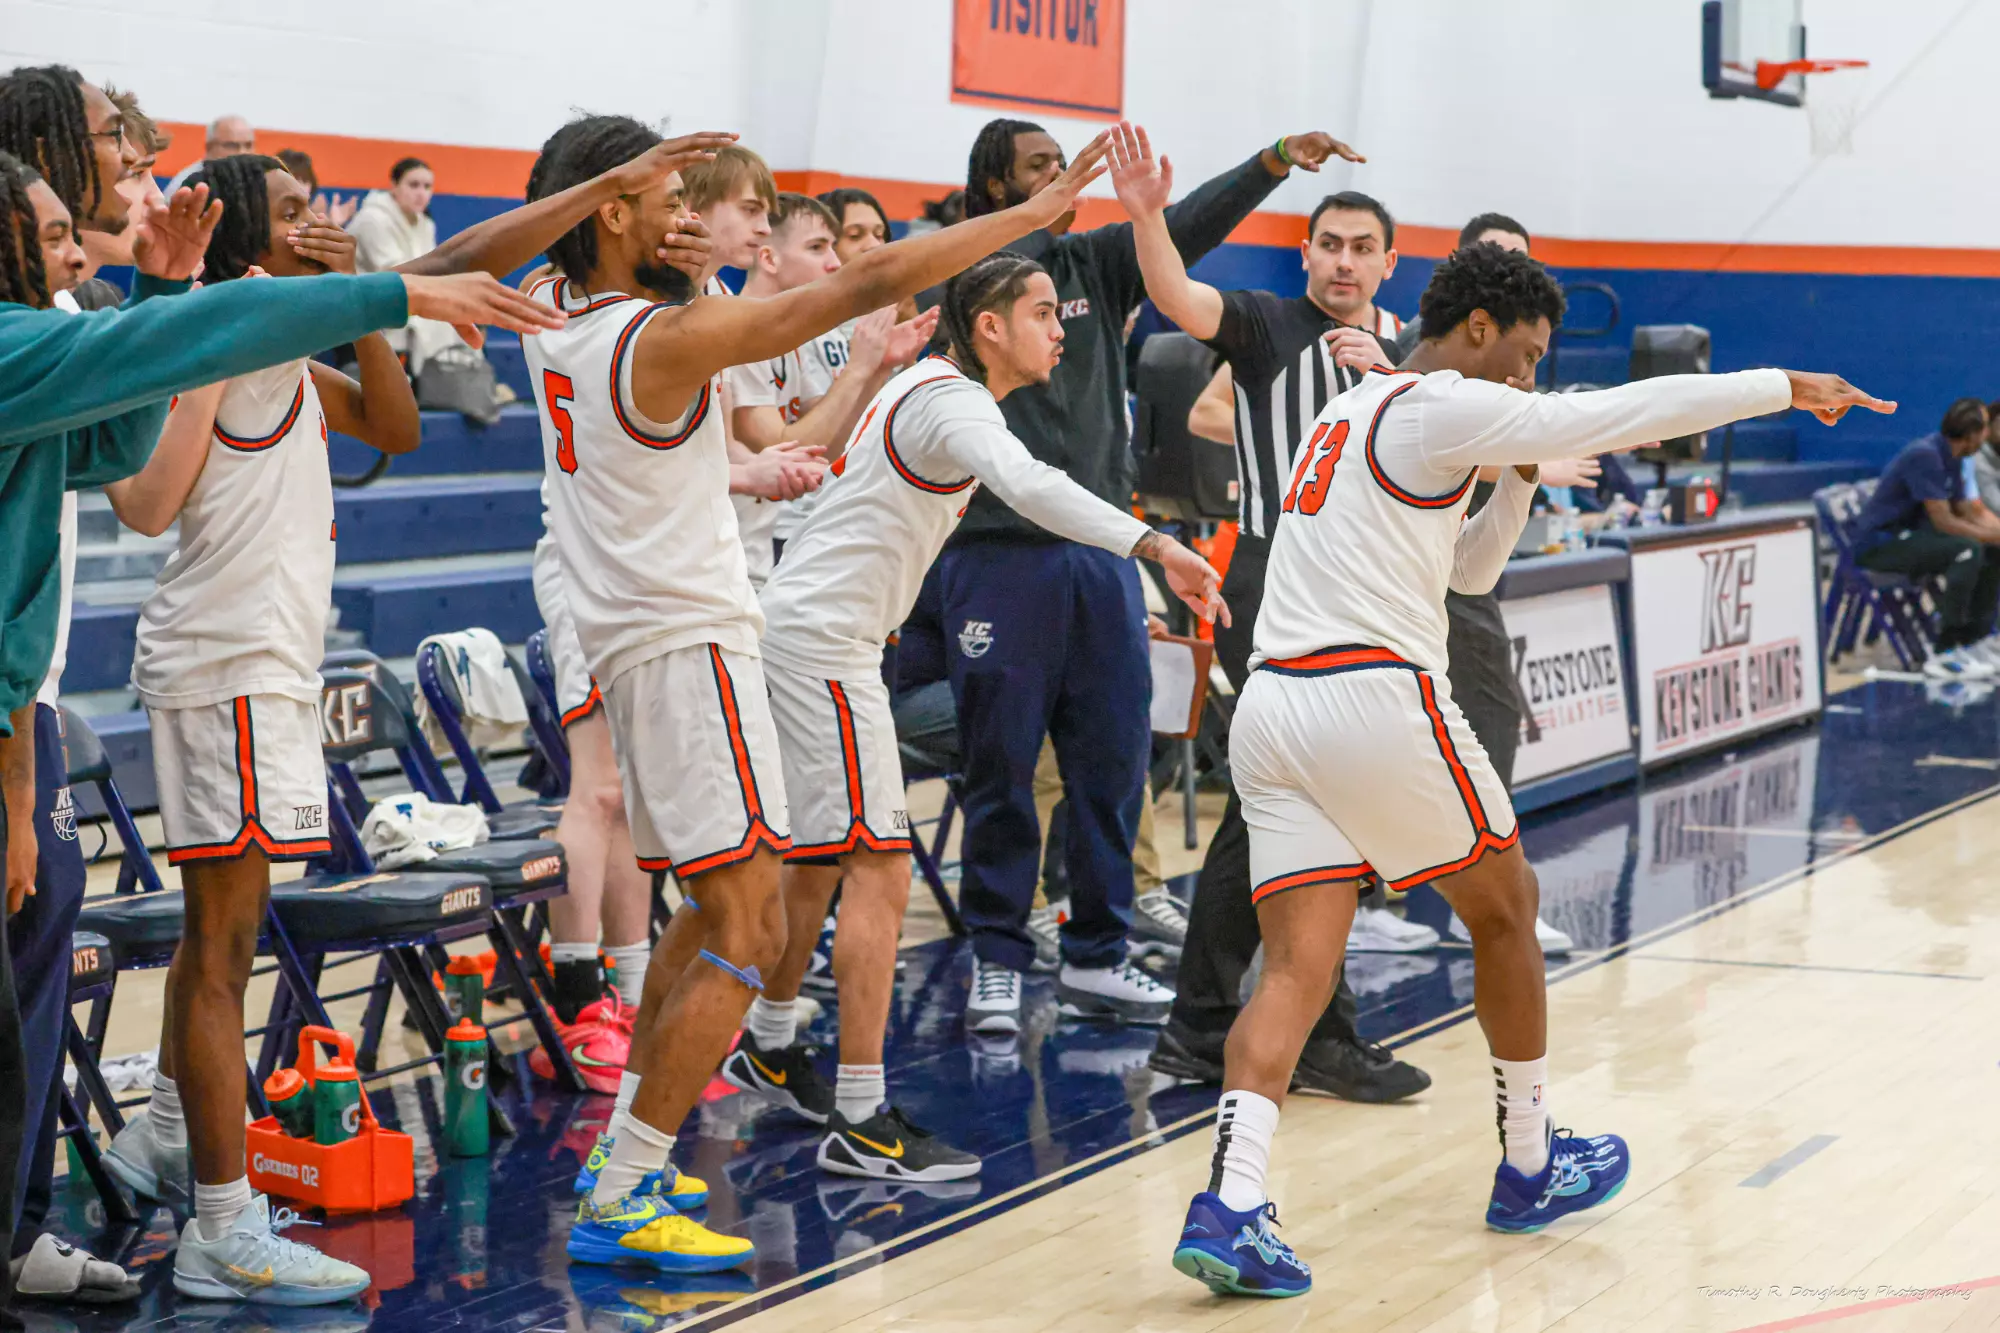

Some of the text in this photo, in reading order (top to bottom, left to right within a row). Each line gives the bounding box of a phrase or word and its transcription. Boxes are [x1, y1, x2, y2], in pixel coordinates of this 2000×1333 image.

[543, 368, 578, 477] 5
[1282, 419, 1350, 516] 13
[1698, 543, 1756, 654] KC
[315, 682, 371, 747] KC
[1655, 644, 1803, 745] KEYSTONE GIANTS
[293, 804, 323, 831] KC
[441, 886, 481, 916] GIANTS
[73, 946, 99, 976] NTS
[461, 1060, 485, 1090] G
